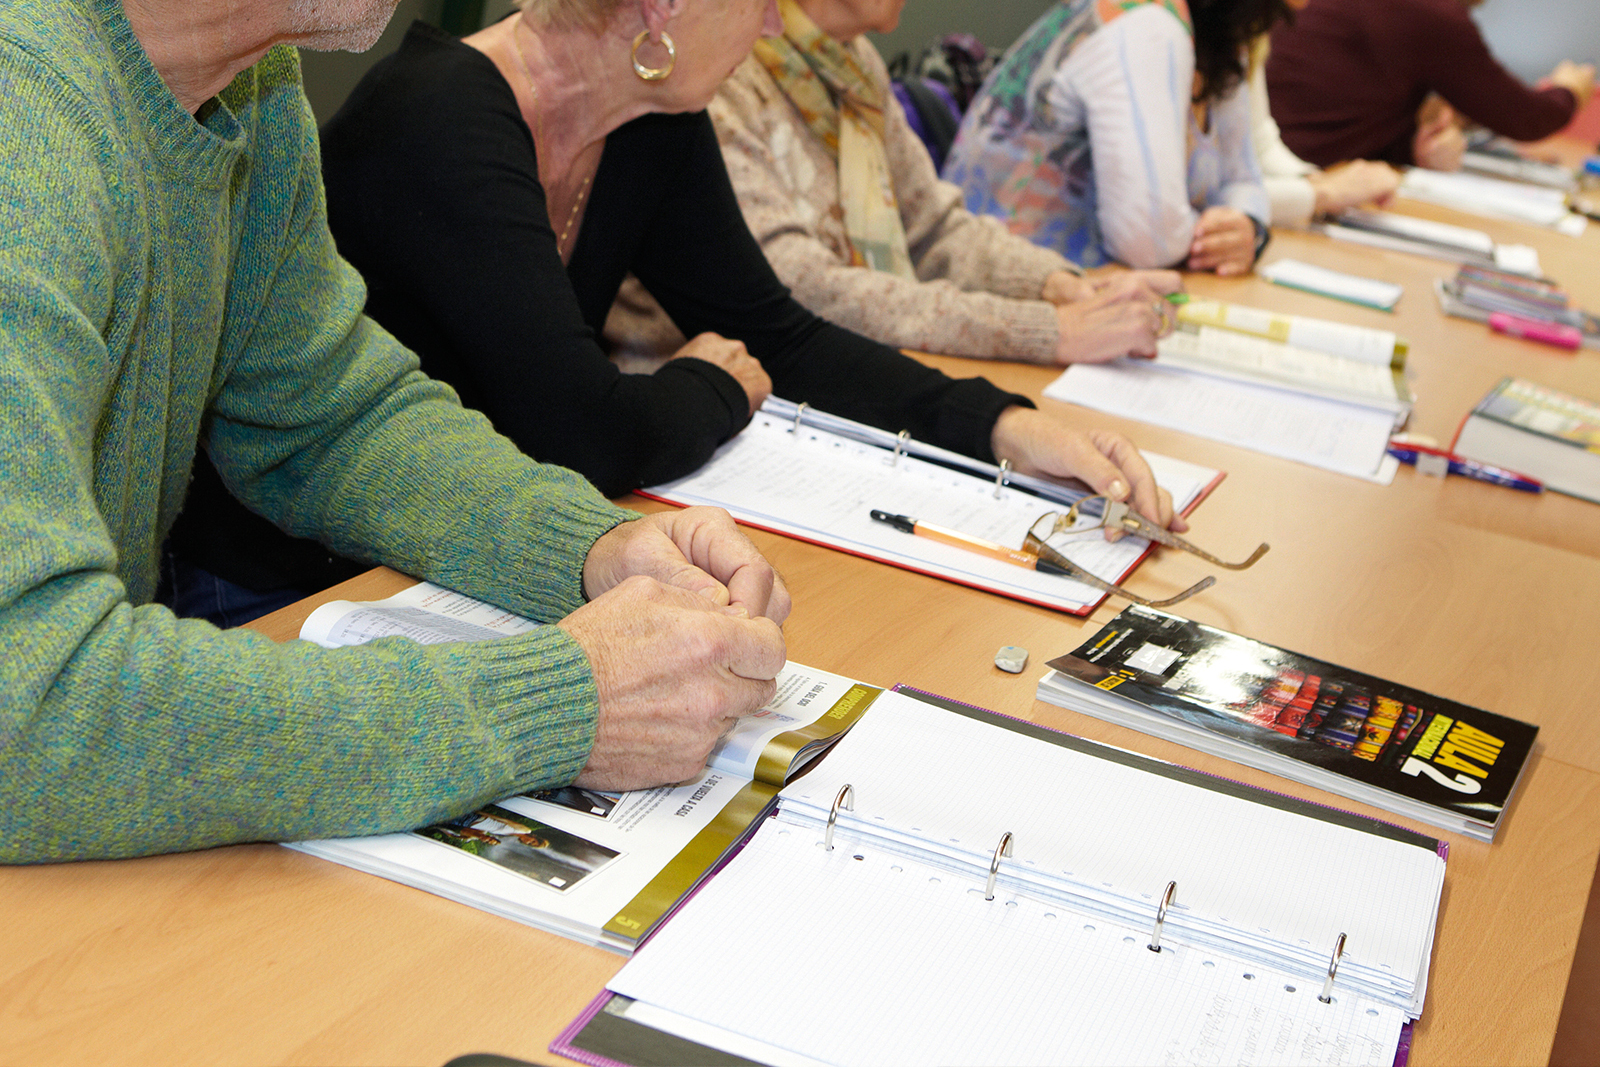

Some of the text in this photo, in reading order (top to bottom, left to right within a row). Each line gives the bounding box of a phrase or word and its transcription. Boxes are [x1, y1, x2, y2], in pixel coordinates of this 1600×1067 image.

[828, 688, 867, 720] COMPRENDER
[1433, 720, 1505, 779] AULA
[705, 778, 718, 786] DE
[1400, 757, 1482, 794] 2
[690, 785, 713, 801] VUELTA
[674, 804, 693, 817] CASA
[615, 916, 641, 930] 5
